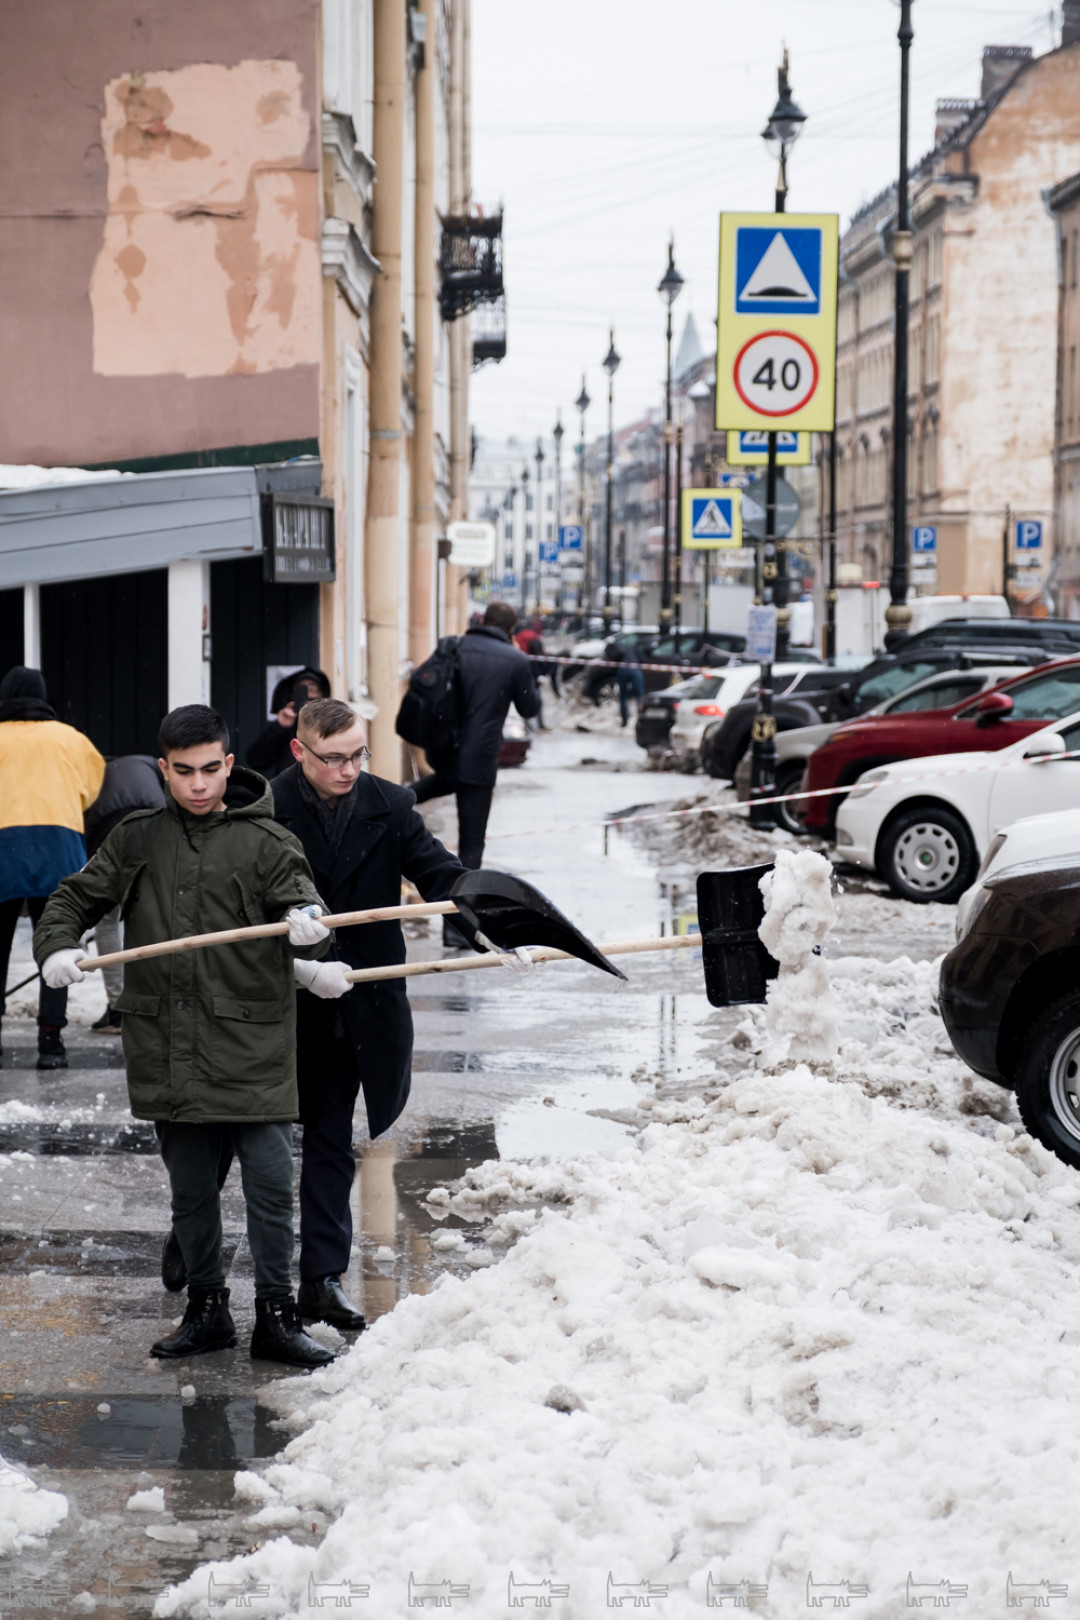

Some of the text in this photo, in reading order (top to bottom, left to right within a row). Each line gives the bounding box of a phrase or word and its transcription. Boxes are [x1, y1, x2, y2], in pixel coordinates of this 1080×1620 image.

[752, 357, 801, 391] 40
[563, 526, 580, 549] P
[917, 527, 934, 549] P
[1023, 522, 1040, 548] P
[544, 542, 558, 562] P
